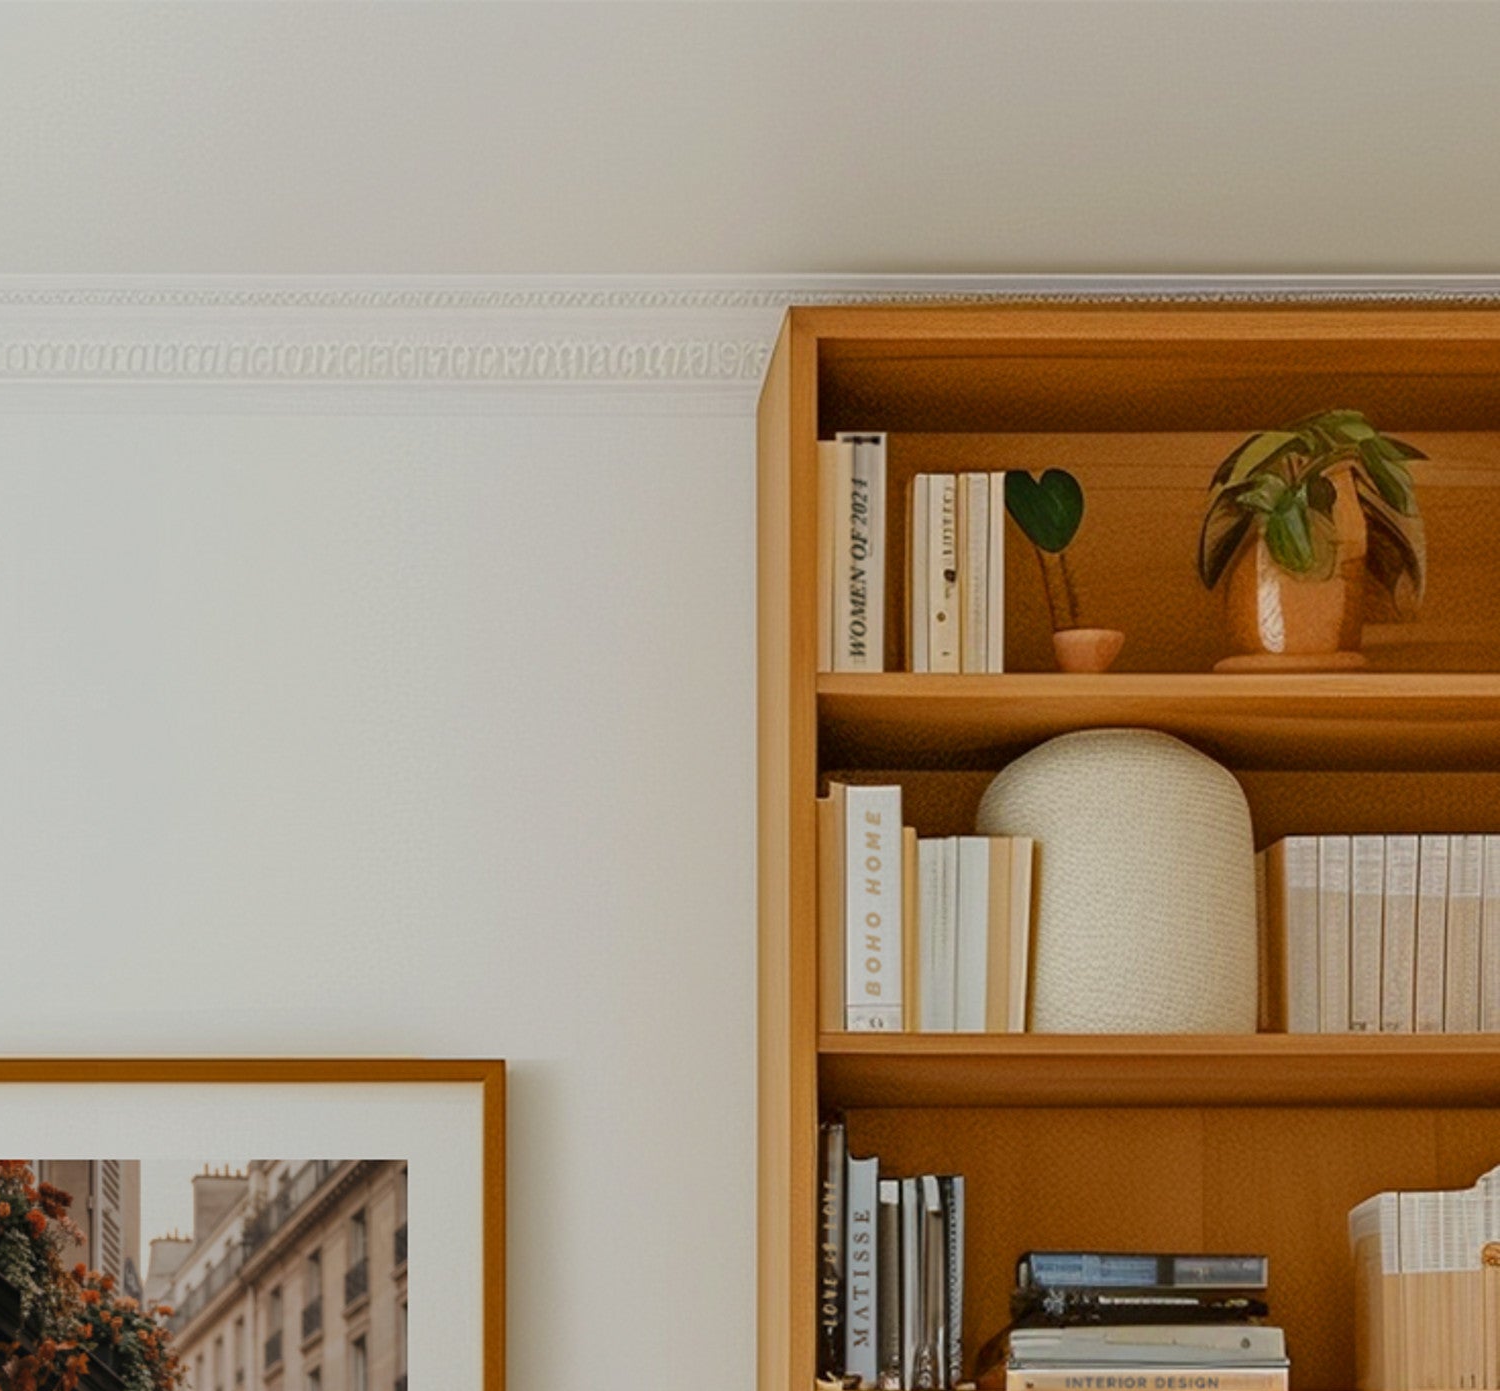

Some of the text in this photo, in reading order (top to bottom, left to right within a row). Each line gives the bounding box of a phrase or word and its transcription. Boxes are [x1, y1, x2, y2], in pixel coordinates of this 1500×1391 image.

[849, 478, 869, 657] WOMEN OF 2024
[865, 811, 881, 996] BOHO HOME
[852, 1209, 870, 1347] MATISSE
[1065, 1376, 1220, 1390] INTERIOR DESIGN
